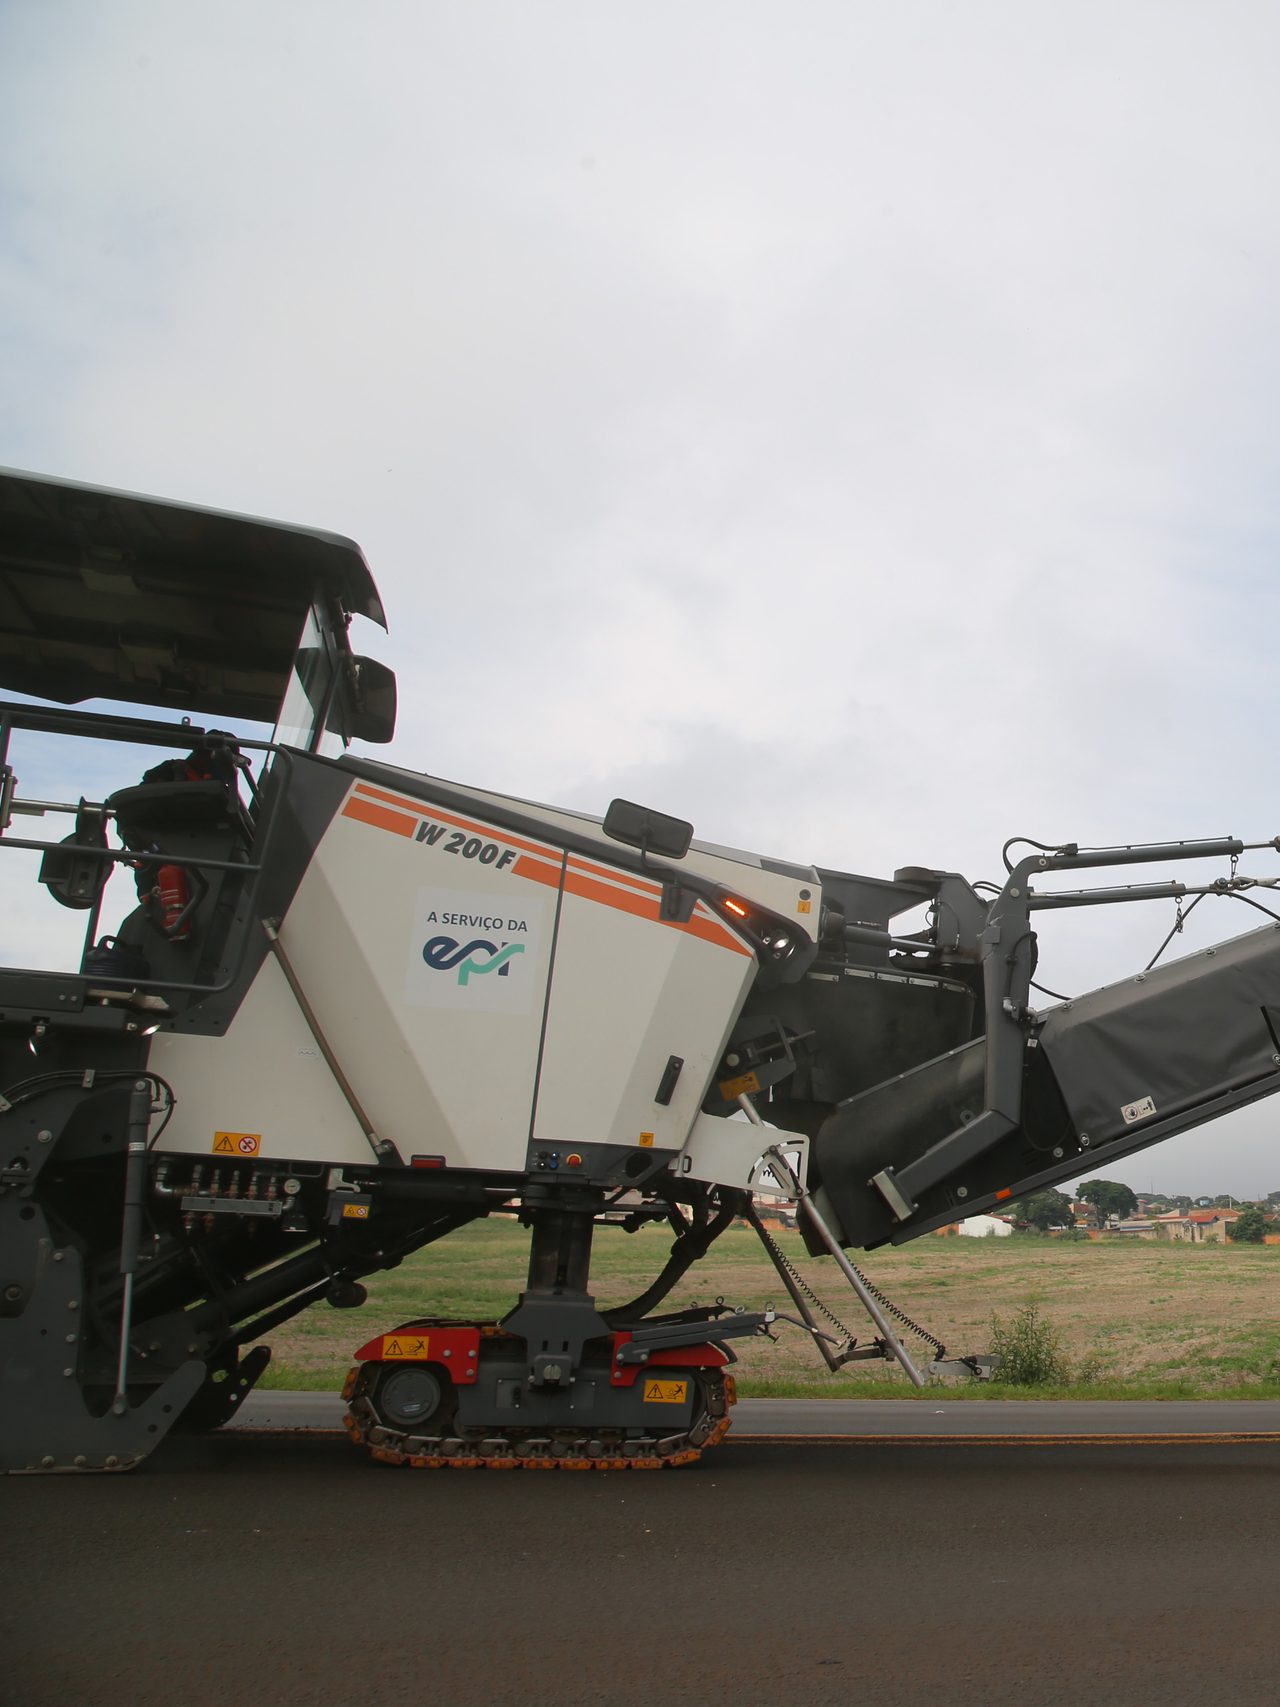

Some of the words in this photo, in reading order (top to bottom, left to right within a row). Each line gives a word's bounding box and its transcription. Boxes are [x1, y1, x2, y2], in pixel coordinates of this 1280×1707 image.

[415, 821, 447, 846] W
[427, 911, 438, 923] A
[442, 912, 503, 931] SERVIÇO
[507, 919, 528, 932] DA
